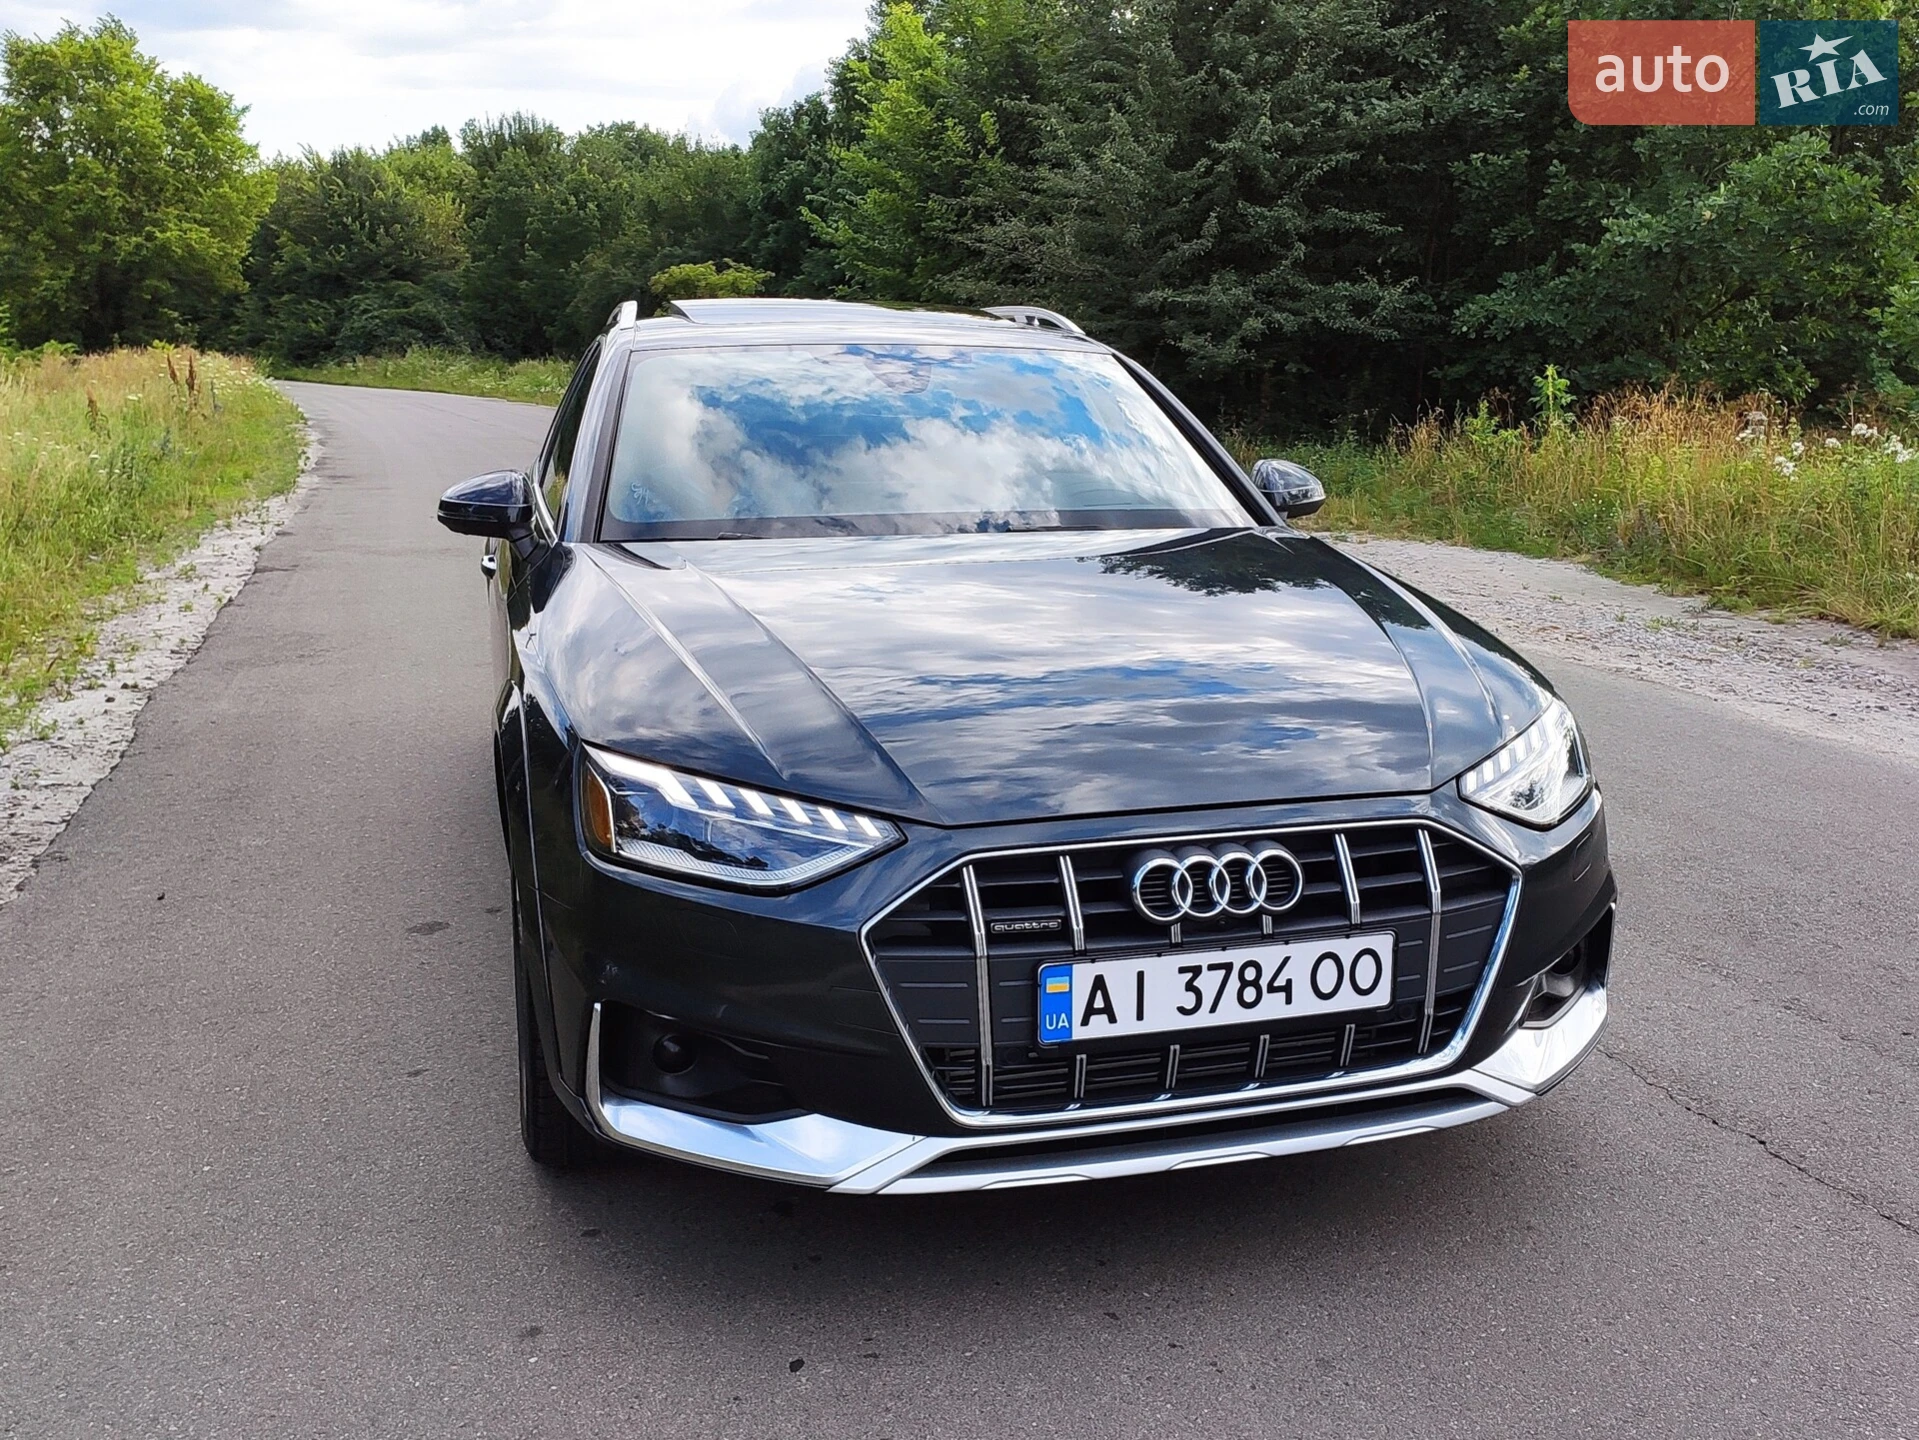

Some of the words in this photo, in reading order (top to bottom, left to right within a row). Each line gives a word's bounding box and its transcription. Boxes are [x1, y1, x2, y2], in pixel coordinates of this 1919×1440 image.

[994, 922, 1058, 932] quattro
[1080, 969, 1144, 1027] AI
[1177, 955, 1293, 1016] 3784
[1046, 1013, 1069, 1030] UA
